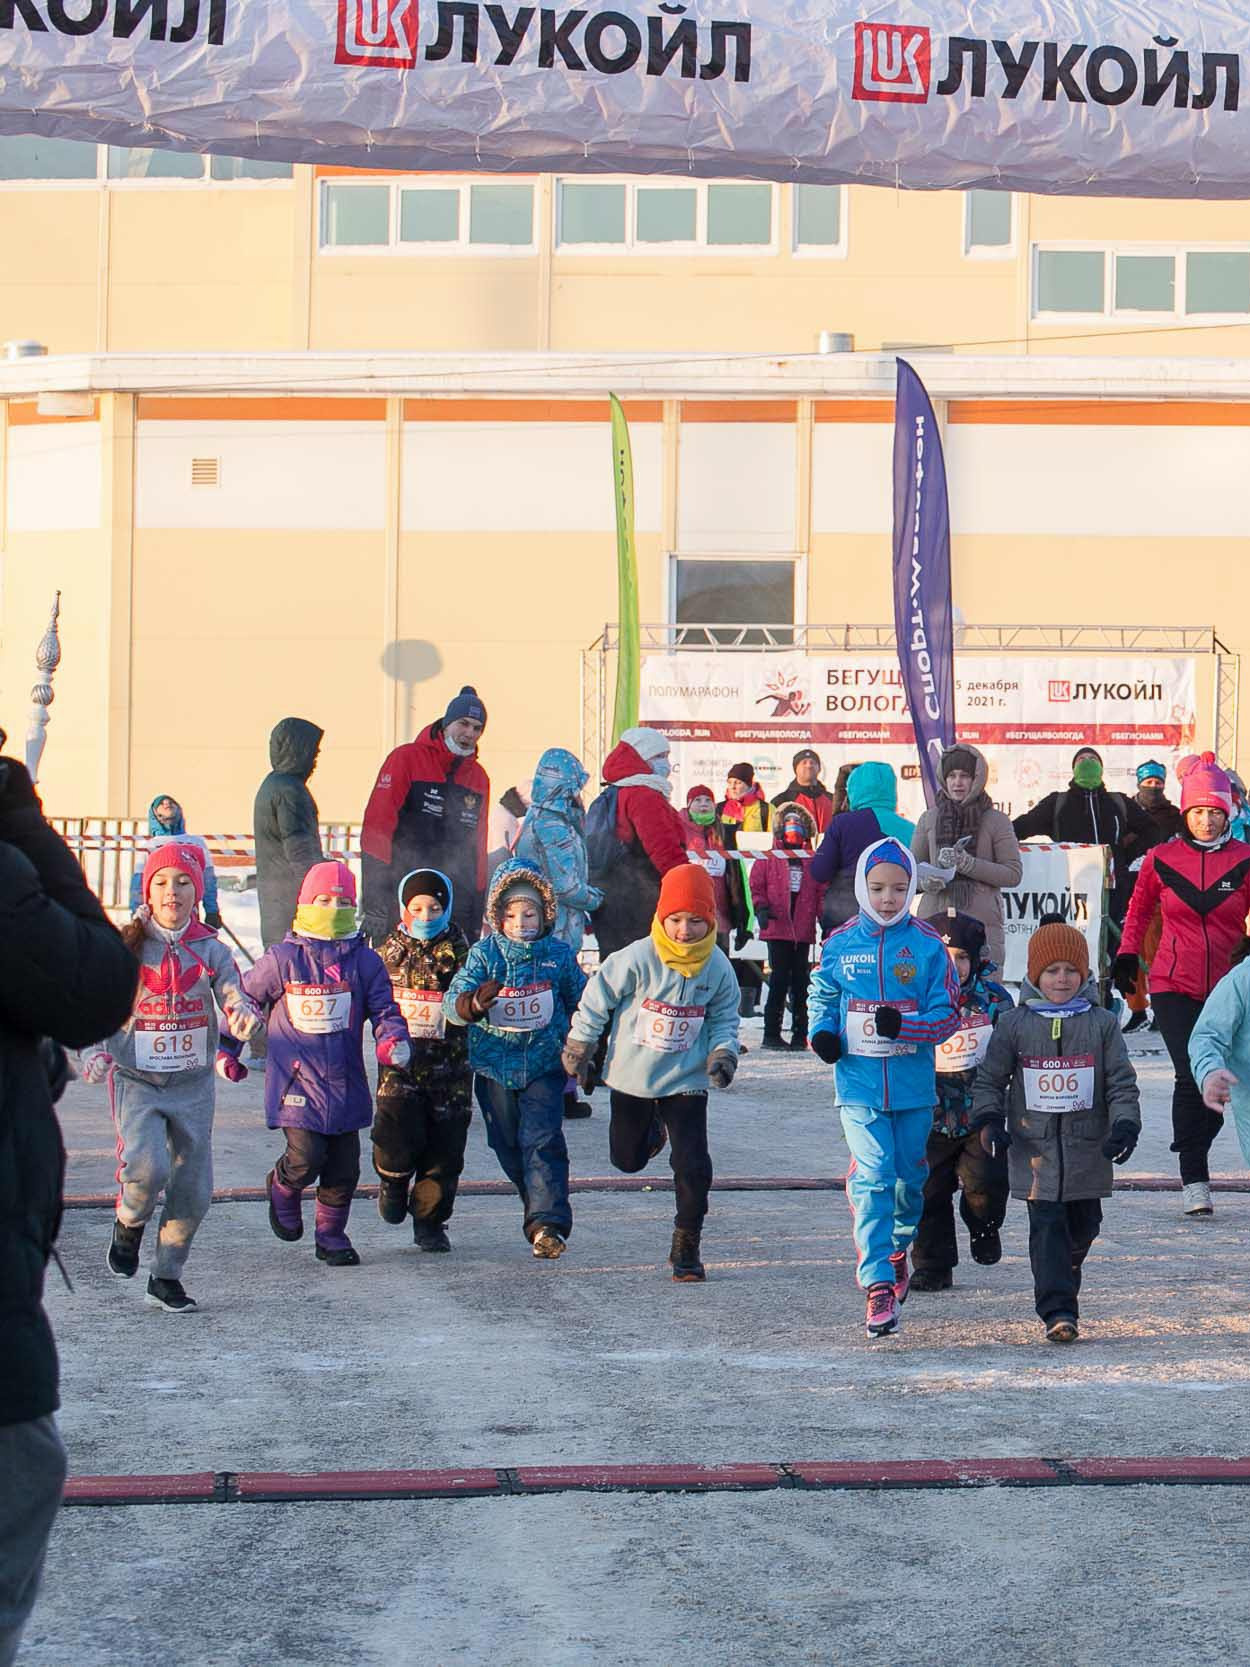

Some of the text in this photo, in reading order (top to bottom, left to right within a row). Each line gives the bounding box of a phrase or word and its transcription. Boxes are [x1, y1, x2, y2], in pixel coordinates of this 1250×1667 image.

[424, 0, 752, 83] ЛУКОЙЛ
[936, 34, 1240, 112] ЛУКОЙЛ
[826, 669, 902, 688] БЕГУЩ
[967, 680, 1019, 692] декабря
[648, 686, 740, 698] ПОЛУМАРАФОН
[1072, 679, 1163, 701] ЛУКОЙЛ
[967, 696, 995, 707] 2021
[840, 954, 877, 964] LUKOIL
[304, 987, 321, 995] 600
[301, 998, 337, 1016] 627
[503, 997, 541, 1017] 616
[661, 1007, 678, 1016] 600
[159, 1023, 178, 1031] 600
[652, 1018, 690, 1038] 619
[153, 1034, 193, 1054] 618
[940, 1032, 979, 1055] 625
[1042, 1060, 1061, 1069] 600
[1038, 1072, 1079, 1093] 606
